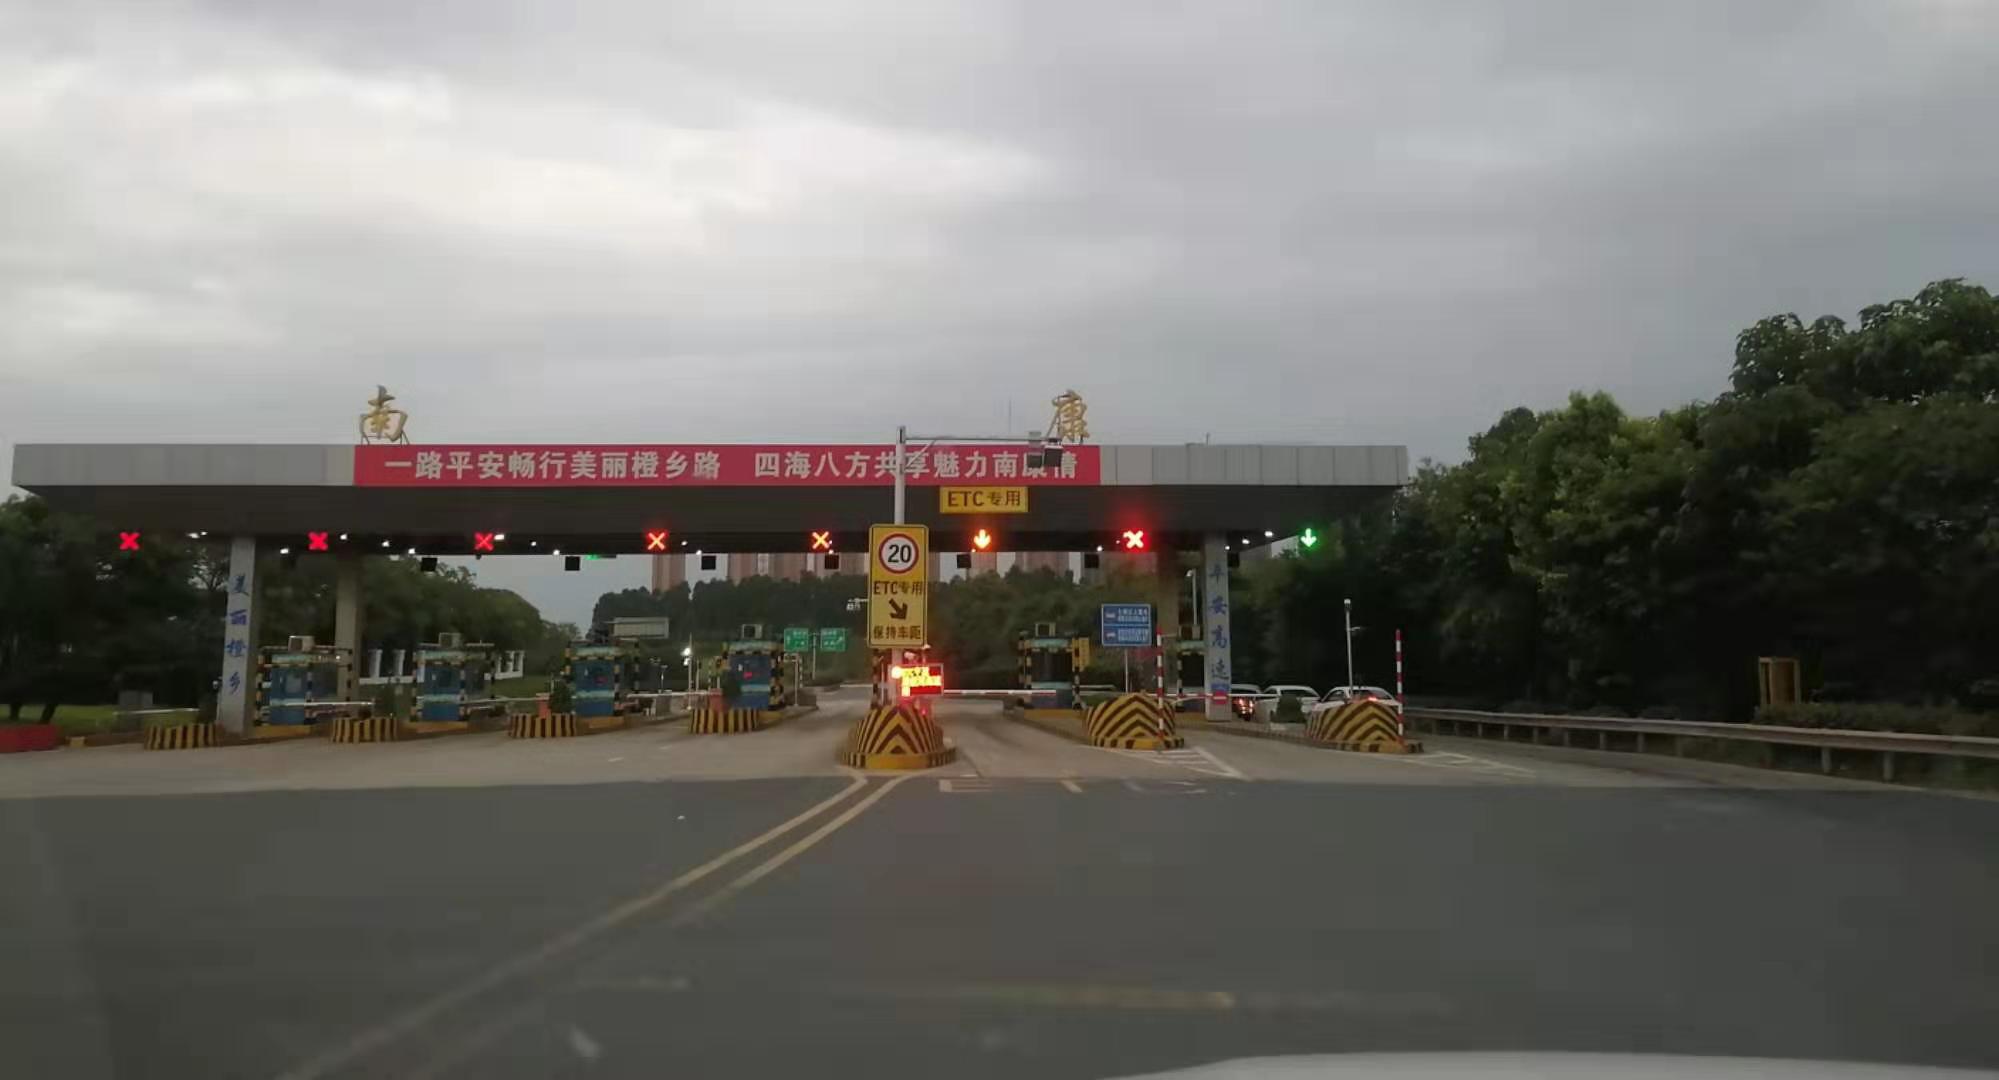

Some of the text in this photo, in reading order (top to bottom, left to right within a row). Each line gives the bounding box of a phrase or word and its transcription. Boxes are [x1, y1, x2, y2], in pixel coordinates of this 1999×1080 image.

[360, 385, 408, 442] 南
[385, 451, 721, 480] 一路平安畅行美丽橙乡路
[888, 544, 912, 563] 20
[873, 625, 921, 641] 保持车距
